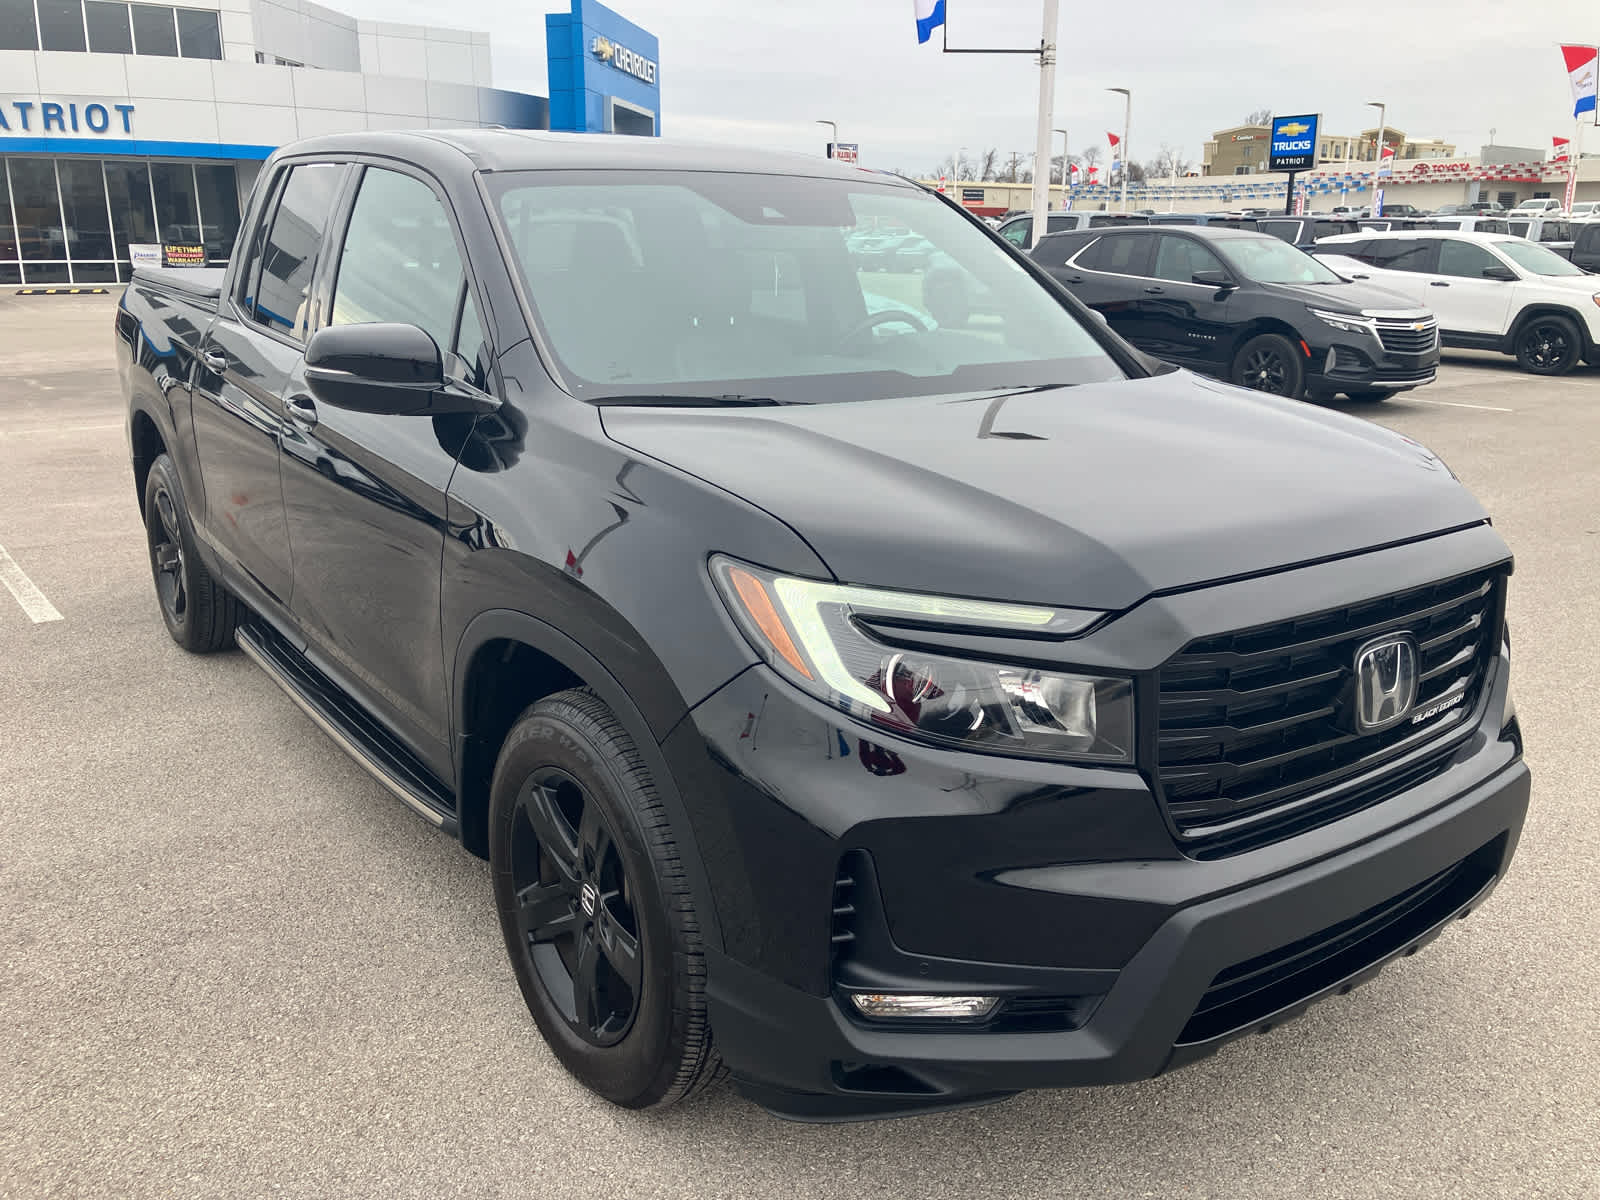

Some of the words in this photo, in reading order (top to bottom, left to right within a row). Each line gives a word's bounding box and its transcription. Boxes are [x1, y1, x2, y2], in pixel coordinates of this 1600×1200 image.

[614, 41, 657, 85] CHEVROLET
[1273, 139, 1311, 152] TRUCKS
[1276, 157, 1305, 166] PATRIOT
[1431, 162, 1470, 173] TOYOTA
[165, 245, 203, 253] LIFETIME
[1411, 705, 1440, 725] BLACK
[1438, 692, 1465, 713] EDITION
